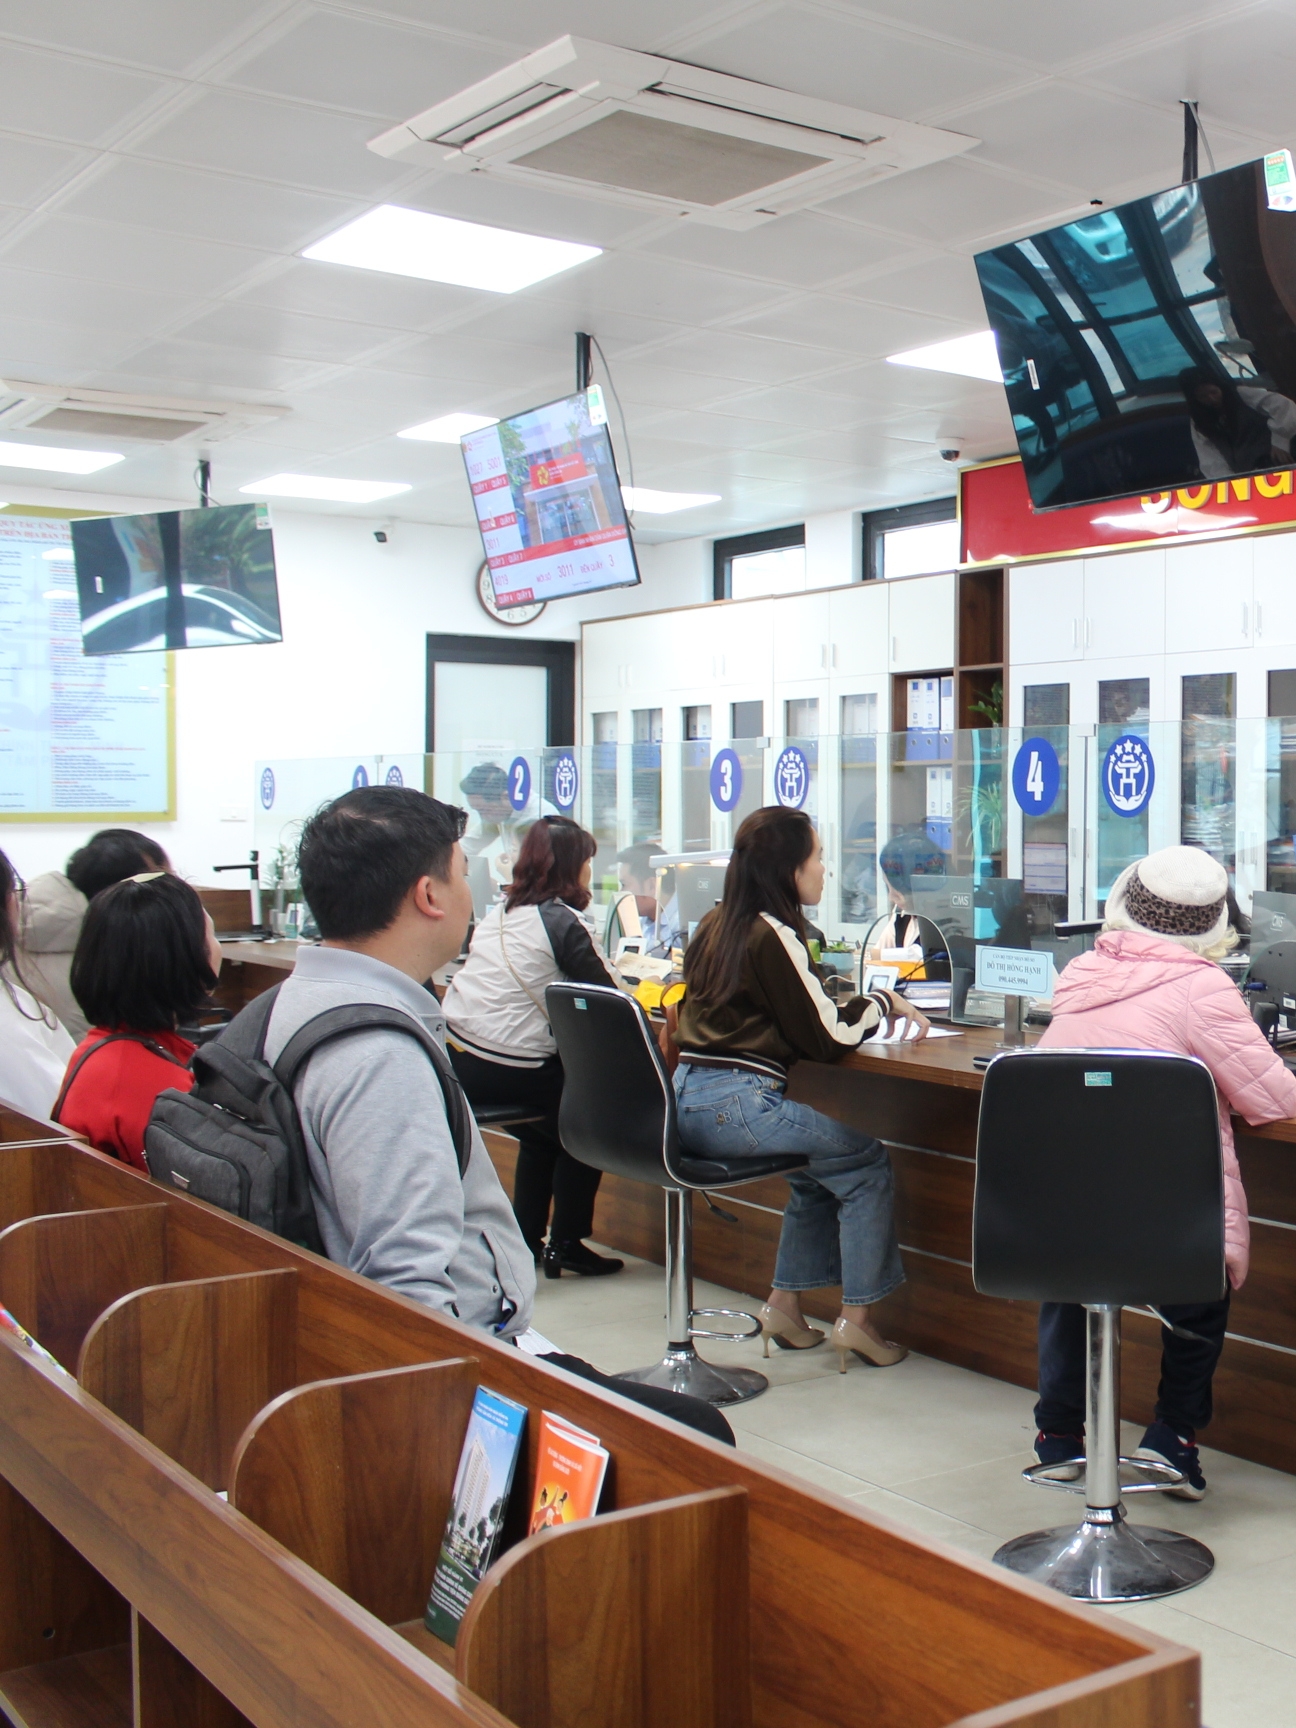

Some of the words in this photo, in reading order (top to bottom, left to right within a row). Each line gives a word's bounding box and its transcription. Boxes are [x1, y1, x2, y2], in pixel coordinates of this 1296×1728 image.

[608, 554, 615, 568] 3
[514, 764, 525, 801] 2
[720, 759, 732, 802] 3
[1026, 750, 1044, 801] 4
[951, 895, 969, 906] CMS
[996, 962, 1006, 973] THỊ
